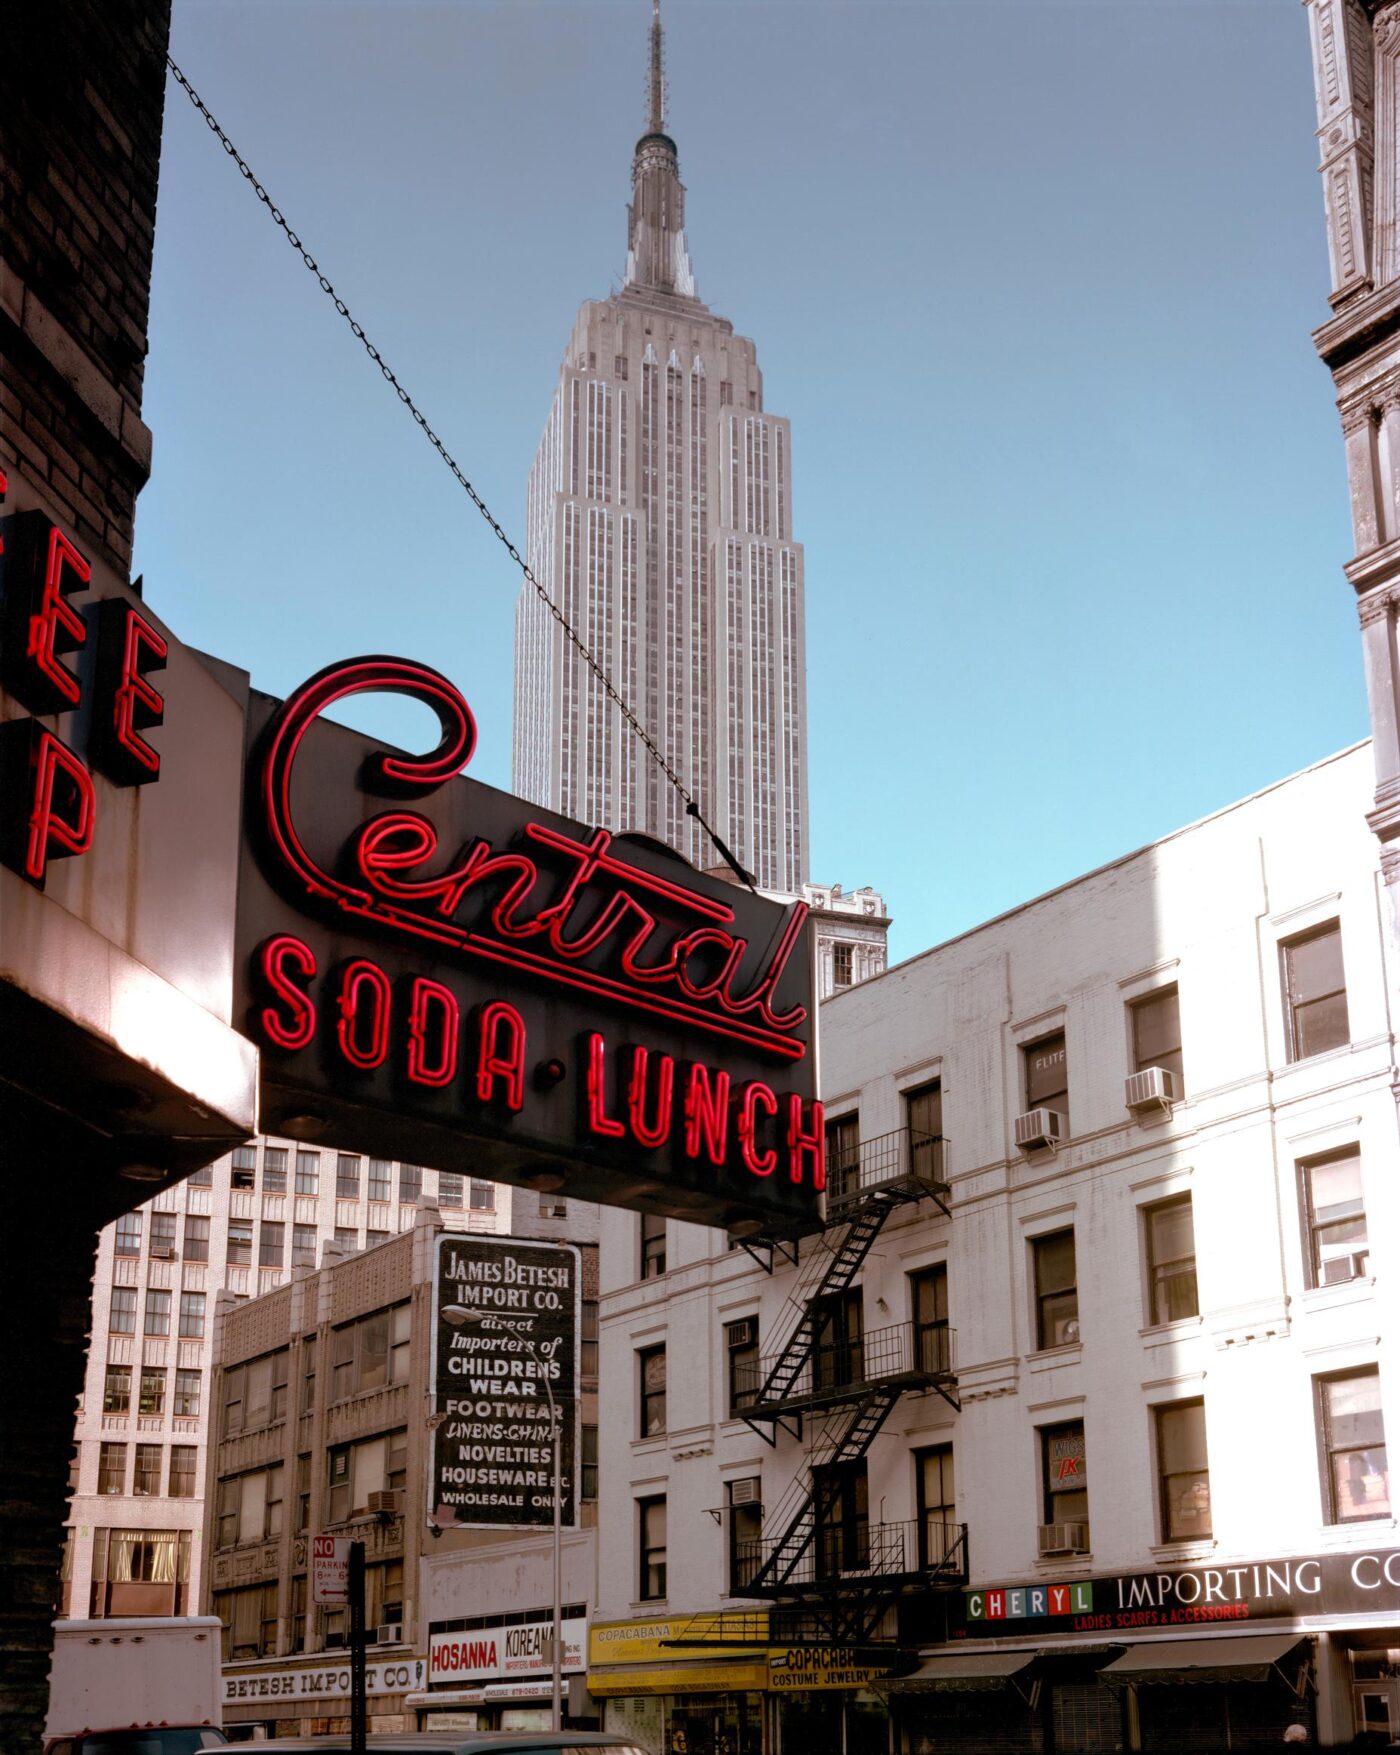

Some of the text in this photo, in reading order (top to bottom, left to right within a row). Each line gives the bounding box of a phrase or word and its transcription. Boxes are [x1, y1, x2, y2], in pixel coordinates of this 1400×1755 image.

[266, 661, 808, 1031] Central
[260, 933, 827, 1192] SODA LUNCH
[445, 1251, 569, 1289] JAMES BETESH
[457, 1284, 564, 1311] IMPORT CO.
[480, 1314, 534, 1332] direct
[450, 1332, 563, 1359] Importers of
[470, 1379, 537, 1396] WEAR
[446, 1399, 564, 1420] FOOTWEAR
[459, 1445, 551, 1464] NOVELTIES
[441, 1467, 570, 1488] HOUSEWARE EC.
[442, 1492, 524, 1507] WHOLESALE
[314, 1540, 334, 1555] NO
[316, 1561, 349, 1569] PARKIN
[970, 1589, 1089, 1616] CHERYL
[1117, 1559, 1321, 1609] IMPORTING
[1075, 1615, 1112, 1630] LADIES
[1117, 1611, 1158, 1627] SCARFS
[1170, 1603, 1249, 1622] ACCESSORIES
[598, 1624, 670, 1641] COPACABANA
[432, 1640, 497, 1672] HOSANNA
[226, 1666, 412, 1698] BETESH IMPOT CO.
[772, 1672, 819, 1687] COSTUME
[824, 1669, 868, 1684] JEWELRY
